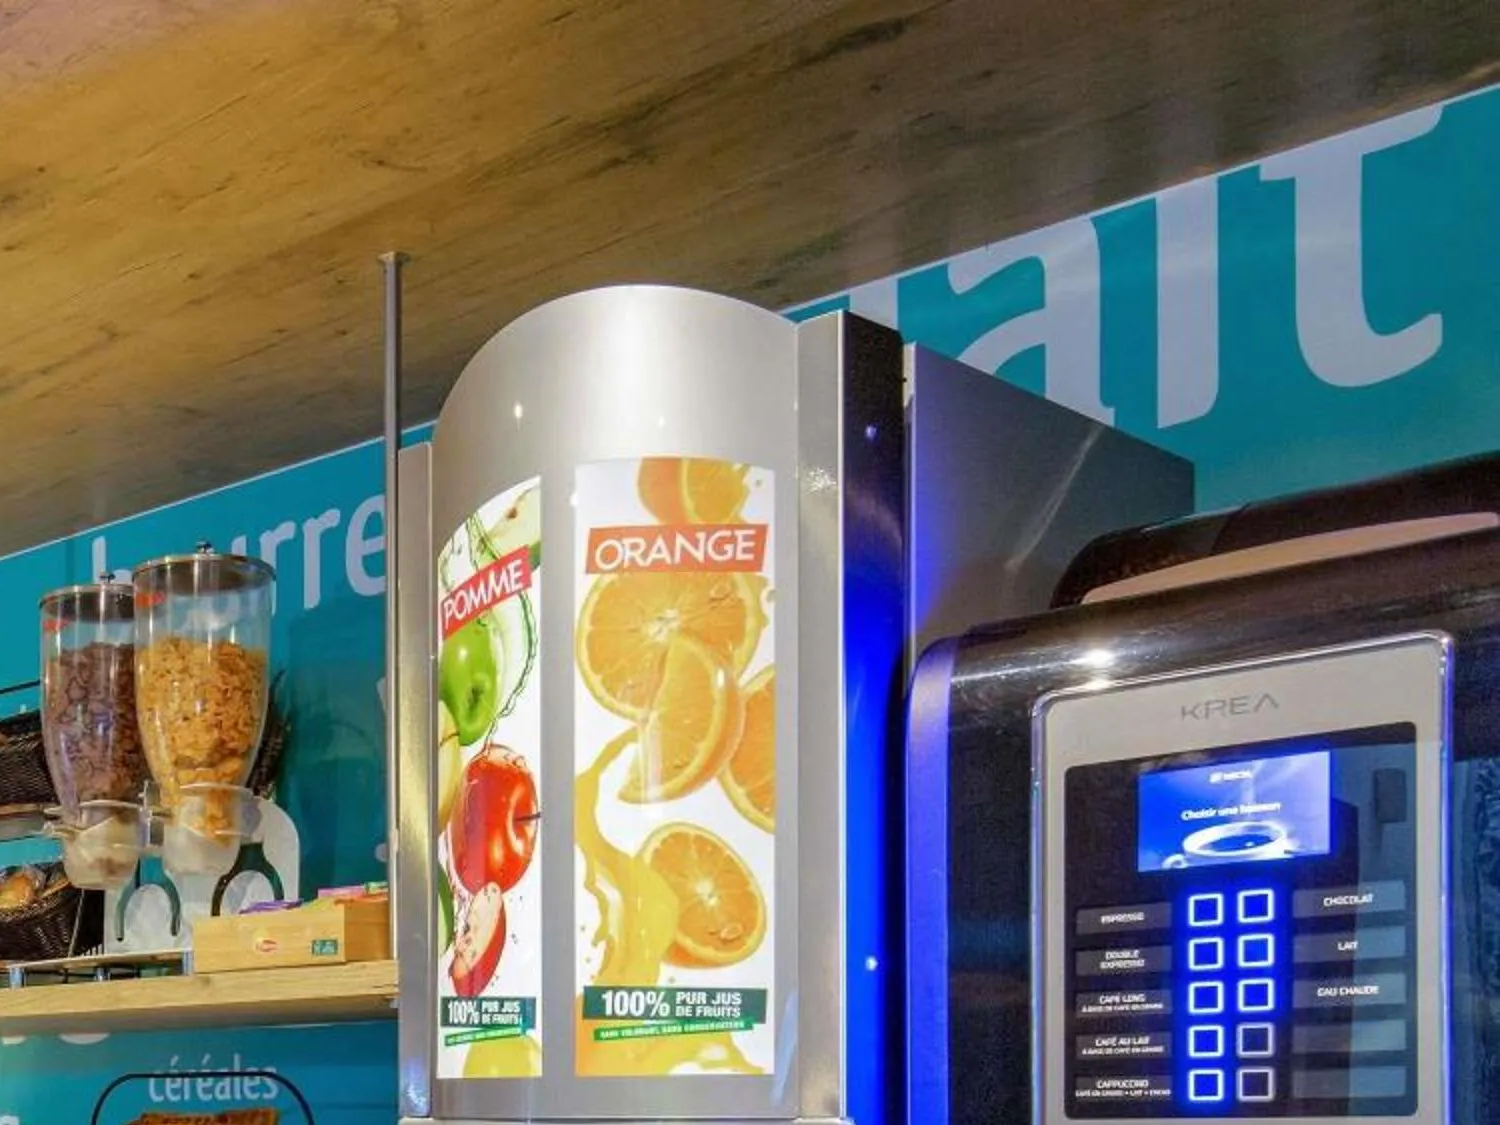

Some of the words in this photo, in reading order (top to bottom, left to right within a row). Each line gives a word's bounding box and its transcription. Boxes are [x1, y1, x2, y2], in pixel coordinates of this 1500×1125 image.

[595, 529, 757, 571] ORANGE
[442, 559, 523, 630] POMME
[1181, 693, 1279, 721] KREA
[1337, 941, 1359, 952] LAIT
[447, 999, 481, 1025] 100%
[601, 989, 670, 1017] 100%
[675, 991, 707, 1005] PUR
[712, 991, 742, 1005] JUS
[675, 1006, 694, 1017] DE
[695, 1005, 741, 1018] FRUITS
[148, 1053, 280, 1102] céréales
